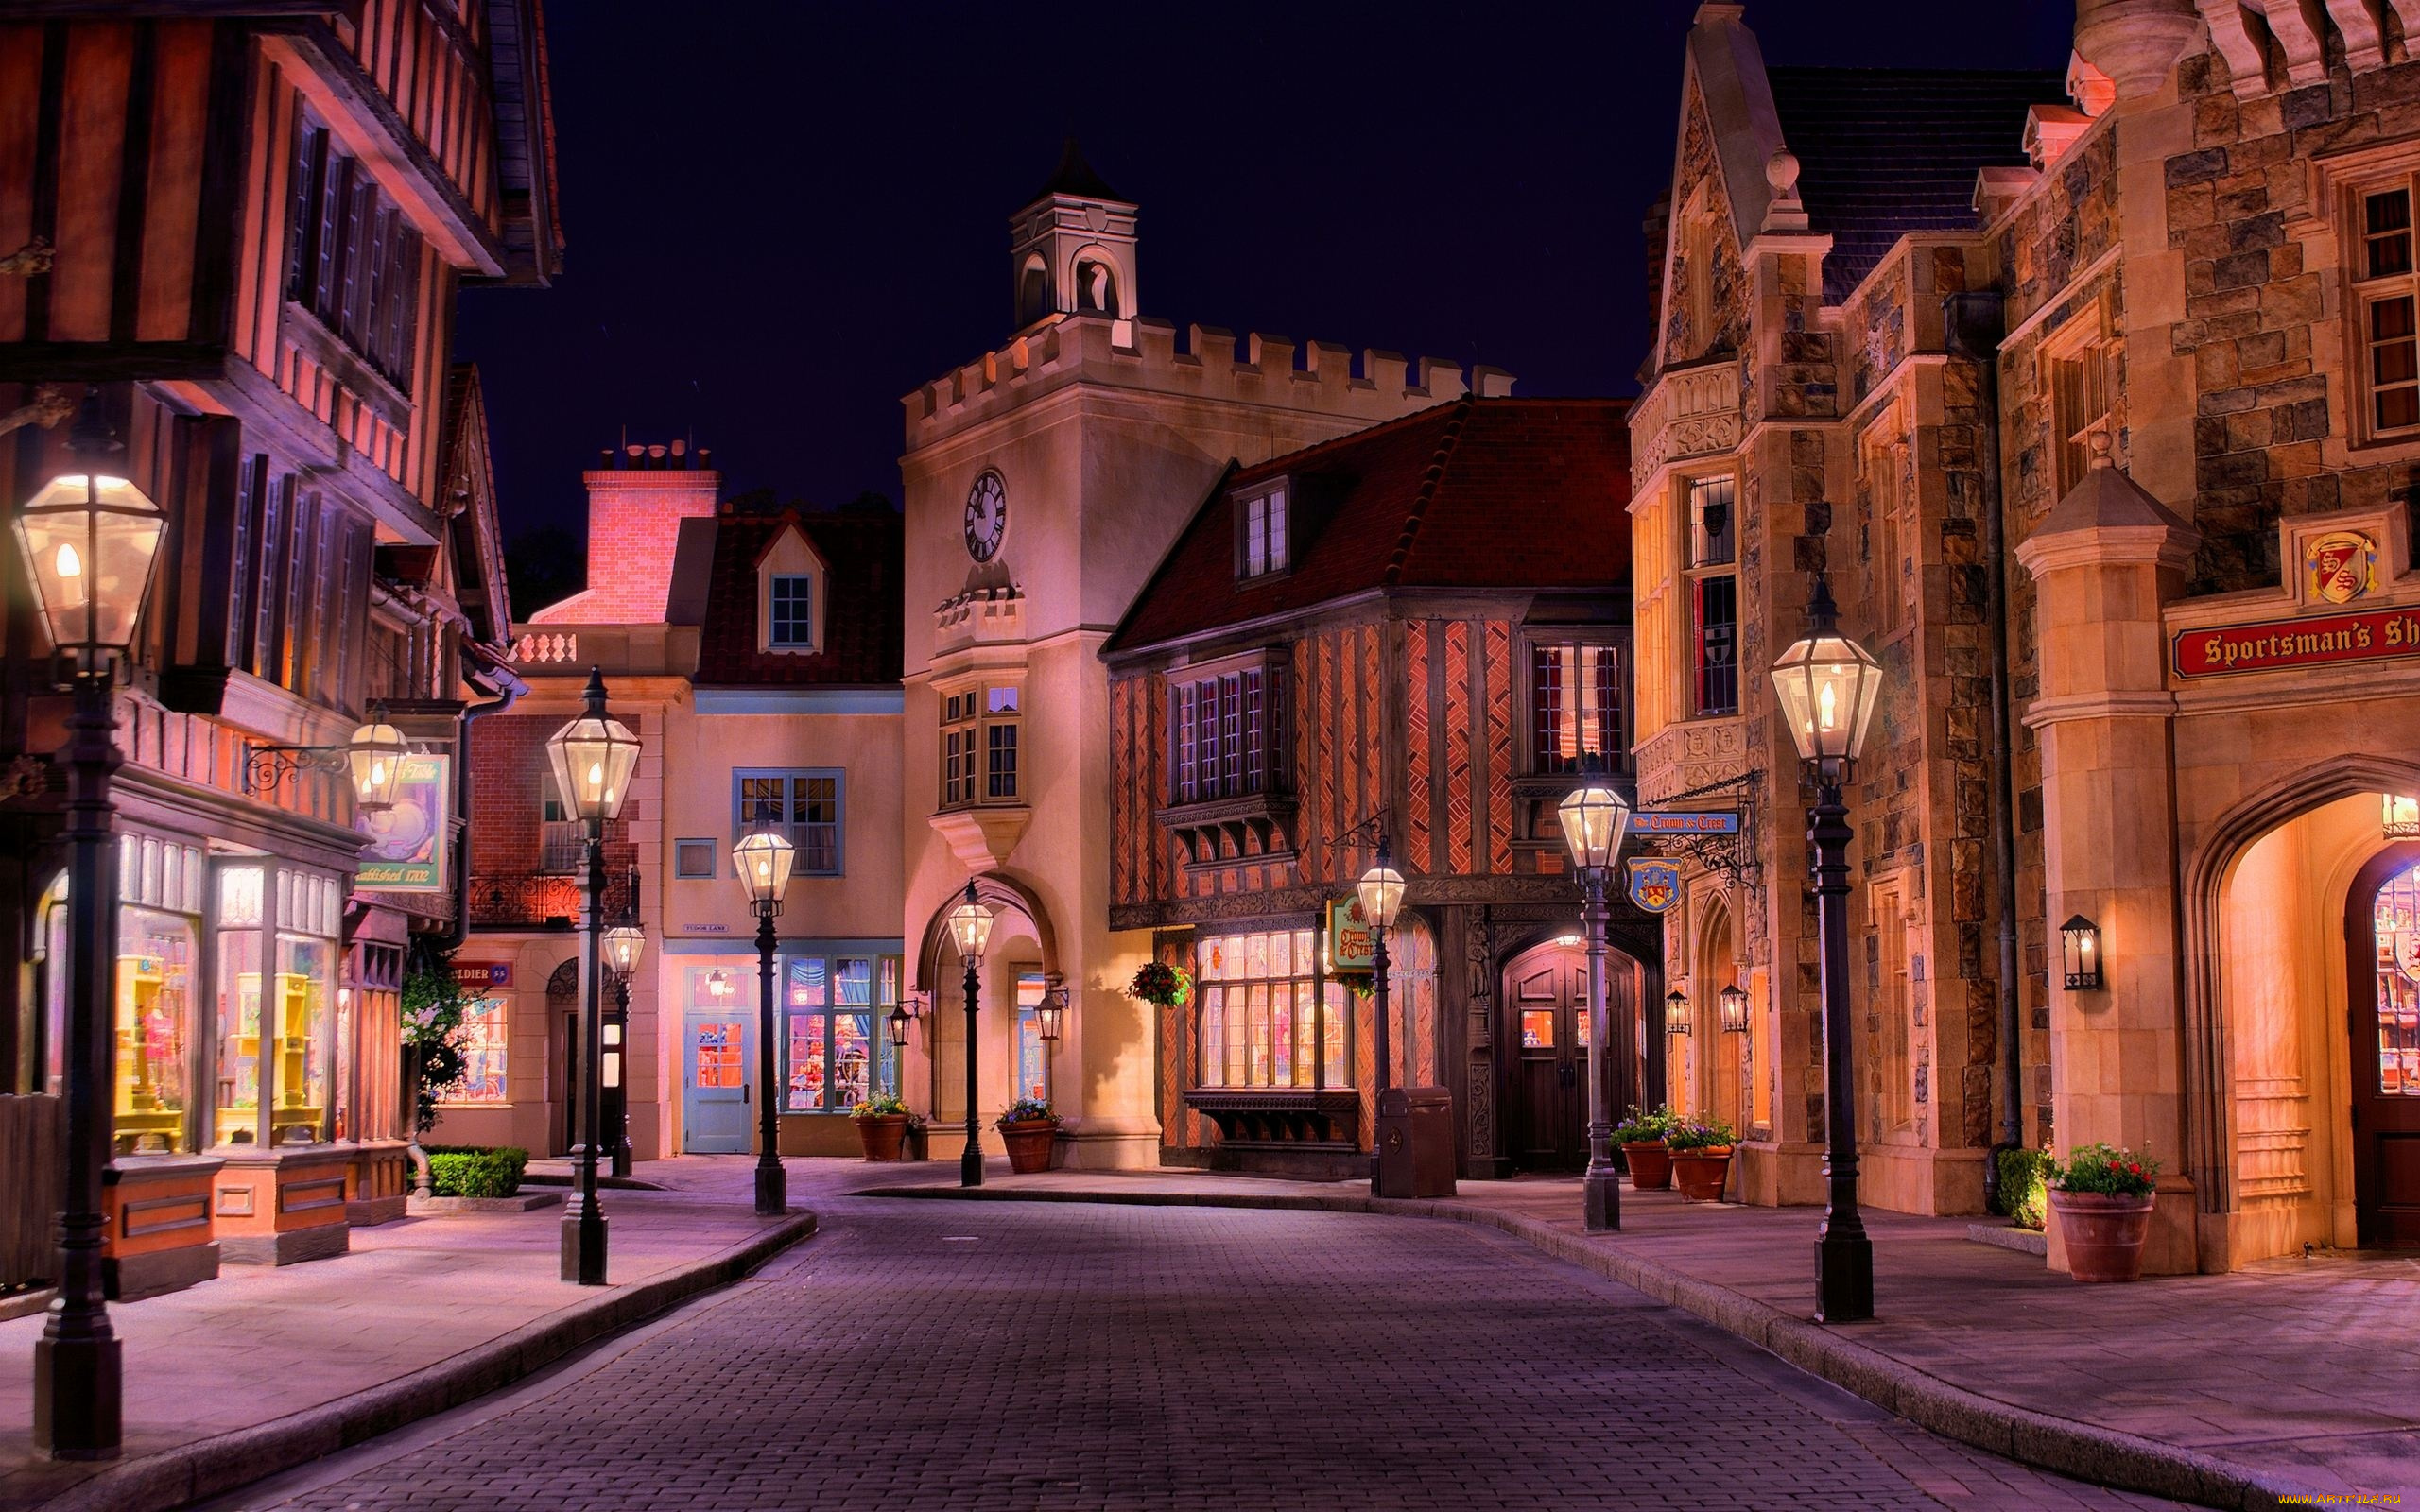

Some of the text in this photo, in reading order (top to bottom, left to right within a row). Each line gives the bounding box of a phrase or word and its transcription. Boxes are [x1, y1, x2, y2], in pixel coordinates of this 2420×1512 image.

[2204, 616, 2420, 668] Sportsman's Sh
[1650, 814, 1684, 831] Crown
[1697, 814, 1726, 831] Crest
[1347, 942, 1374, 960] Crest
